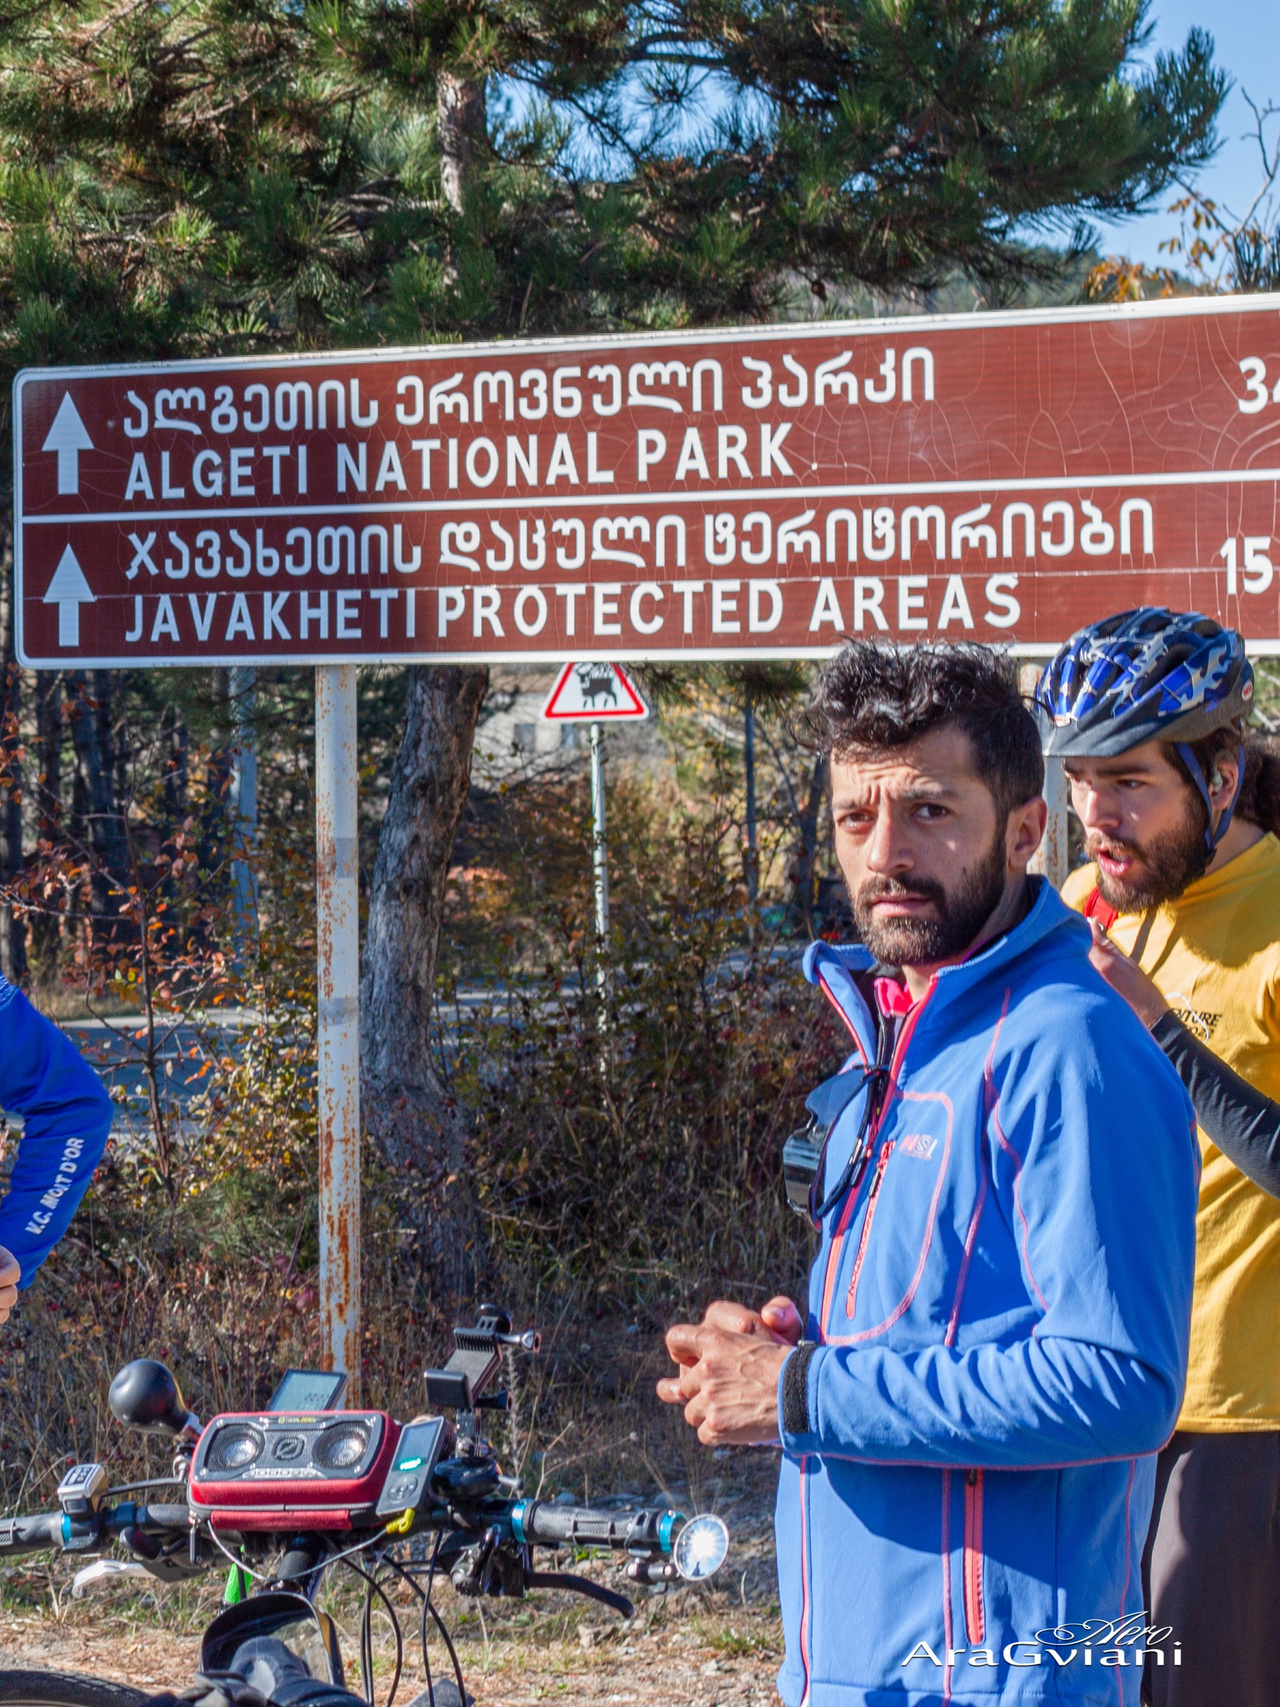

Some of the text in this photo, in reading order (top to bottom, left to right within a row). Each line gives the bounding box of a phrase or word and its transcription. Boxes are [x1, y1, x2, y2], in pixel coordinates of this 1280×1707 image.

[123, 347, 935, 438] ალგეთის ეროვნული პარკი
[1238, 356, 1280, 414] 3
[124, 422, 795, 500] ALGETI NATIONAL PARK
[125, 498, 1154, 580] ჯავახეთის დაცული ტერიტორიები
[1219, 536, 1274, 594] 15
[125, 573, 1021, 642] JAVAKHETI PROTECTED AREAS
[59, 1137, 85, 1174] D'OR
